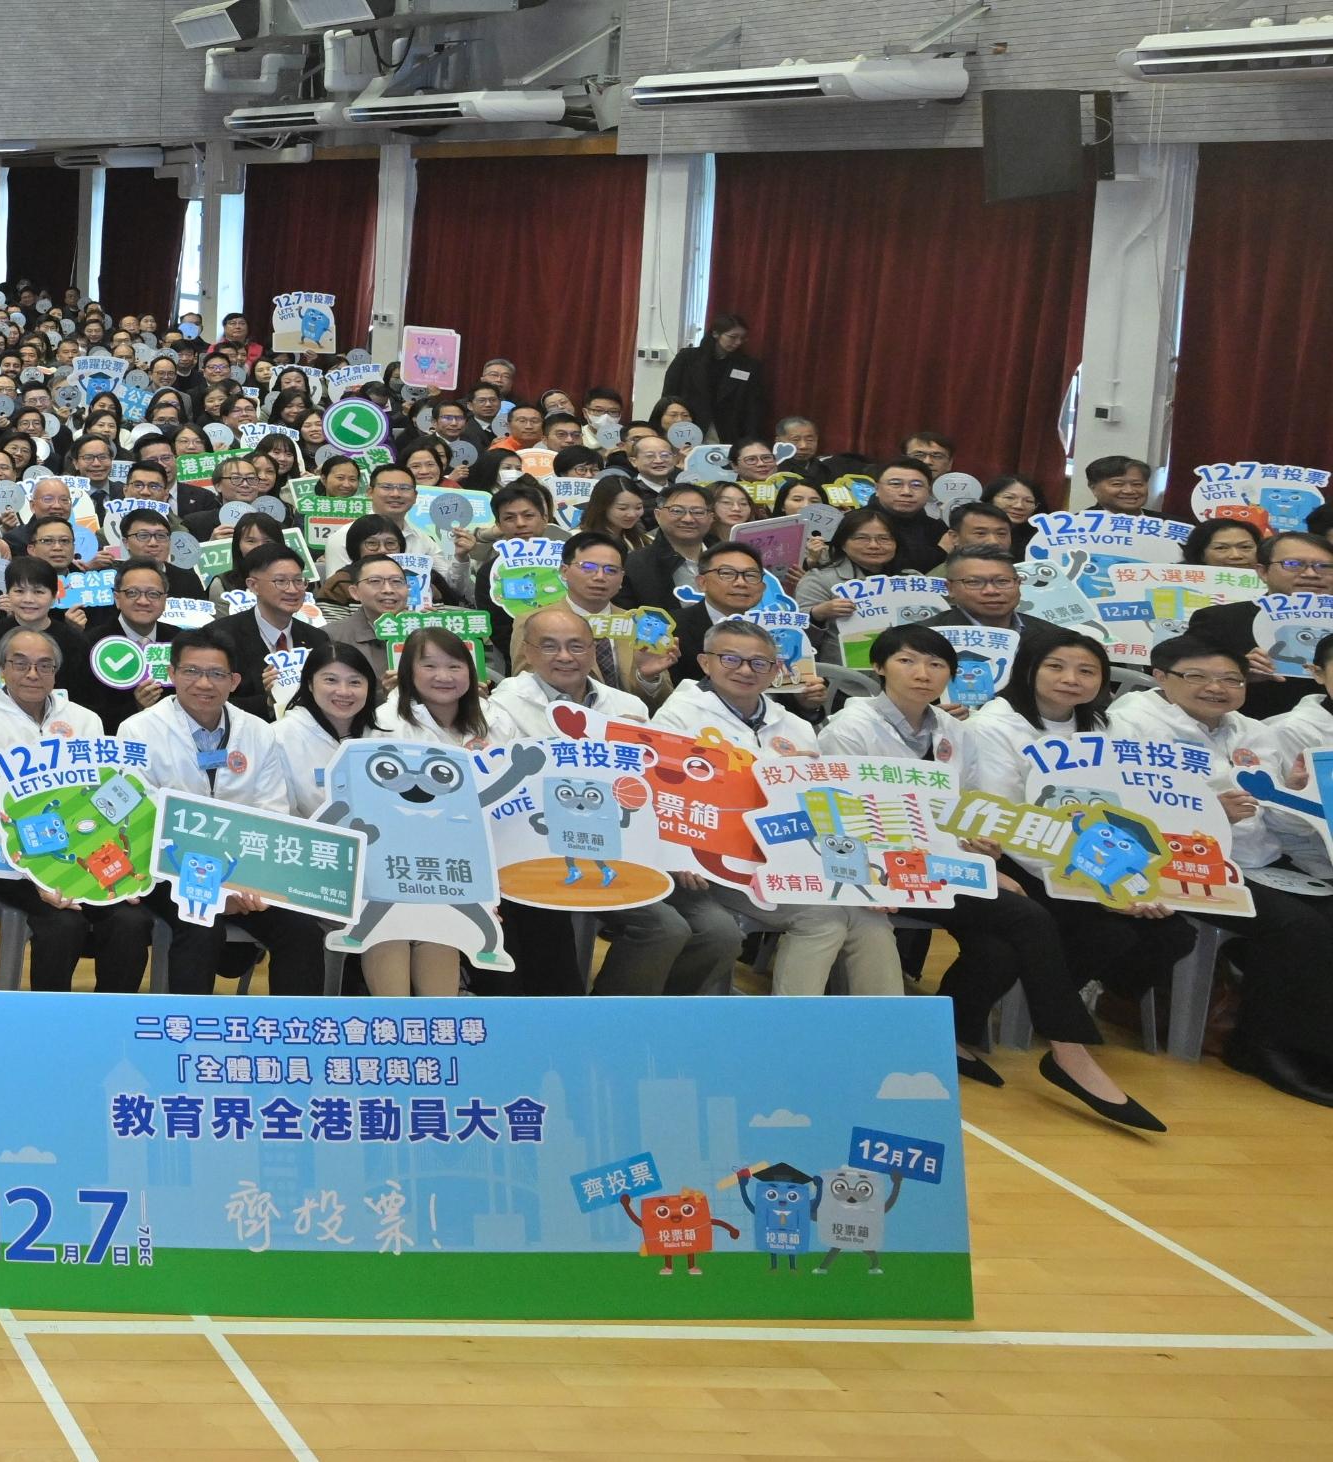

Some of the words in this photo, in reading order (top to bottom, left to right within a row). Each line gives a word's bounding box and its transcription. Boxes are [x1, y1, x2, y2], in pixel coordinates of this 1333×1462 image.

[275, 293, 303, 306] 12.7
[304, 294, 334, 305] 齊投票
[1199, 464, 1256, 482] 12.7
[1261, 466, 1329, 487] 齊投票
[1199, 482, 1232, 493] LET'S
[1203, 490, 1236, 500] VOTE
[1033, 514, 1105, 536] 12.7
[1110, 516, 1190, 541] 齊投票
[496, 540, 546, 559] 12.7
[1048, 535, 1088, 546] LET'S
[1091, 535, 1133, 546] VOTE
[836, 578, 886, 599] 12.7
[857, 606, 889, 618] VOTE
[1103, 605, 1150, 617] 12月7日
[67, 741, 149, 767] 齊投票
[552, 740, 642, 772] 齊投票
[1023, 734, 1104, 775] 12.7
[1111, 739, 1213, 778] 齊投票
[760, 762, 851, 787] 投入選舉
[857, 763, 950, 790] 共創未來
[1148, 788, 1204, 812] VOTE
[561, 830, 605, 847] 投票箱
[762, 817, 811, 840] 12月7日
[239, 830, 354, 872] 齊投票!
[385, 855, 473, 884] 投票箱
[398, 883, 435, 896] Ballot
[438, 884, 465, 897] Box
[768, 874, 823, 893] 教育局
[135, 1016, 487, 1046] 二零二五年立法會換屆選舉
[177, 1056, 313, 1084] 「全體動員
[325, 1057, 459, 1086] 選賢與能」
[112, 1094, 547, 1143] 教育界全港動員大會
[858, 1139, 937, 1174] 12月7日
[580, 1160, 654, 1202] 齊投票
[139, 1238, 150, 1264] DEC
